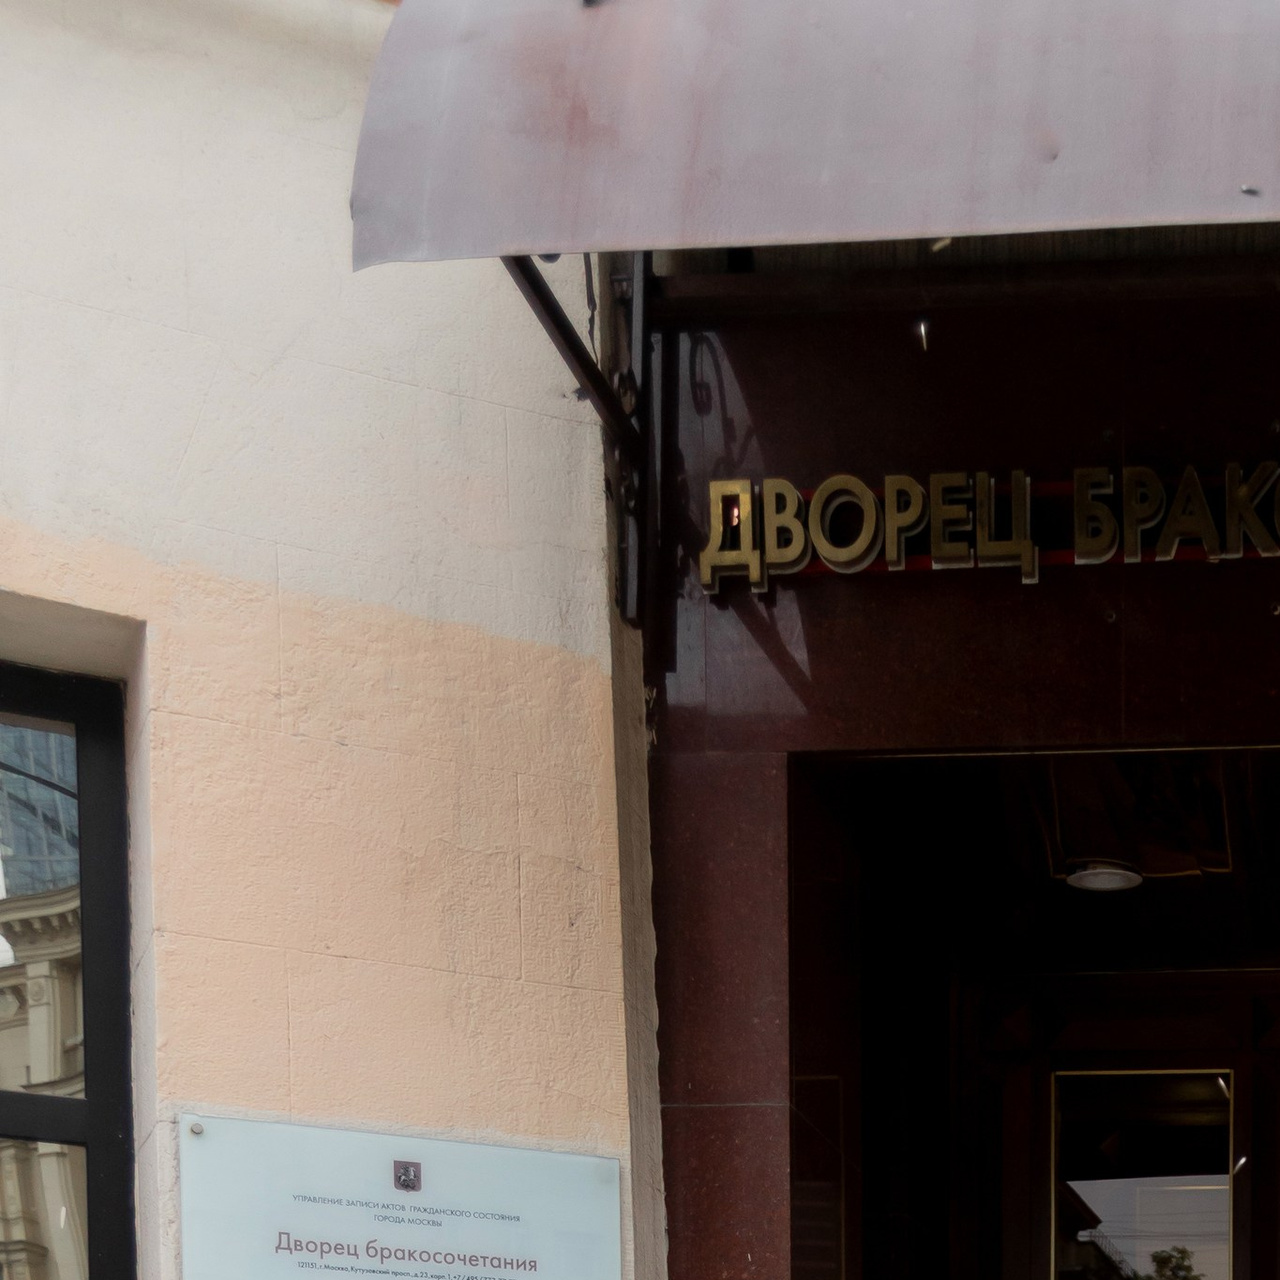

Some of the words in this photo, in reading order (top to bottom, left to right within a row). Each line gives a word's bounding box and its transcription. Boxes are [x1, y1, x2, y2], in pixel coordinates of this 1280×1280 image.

[700, 470, 1038, 590] ДВОРЕЦ
[292, 1194, 343, 1206] УПРАВЛЕНИЕ
[345, 1199, 379, 1209] ЗАПИСИ
[381, 1203, 406, 1212] АКТОВ
[410, 1205, 471, 1218] ГРАЖДАНСКОГО
[473, 1211, 520, 1222] СОСТОЯНИЯ
[374, 1214, 405, 1224] ГОРОДА
[407, 1218, 442, 1227] МОСКВЫ
[275, 1231, 359, 1259] Дворец
[365, 1239, 538, 1271] бракосочетания
